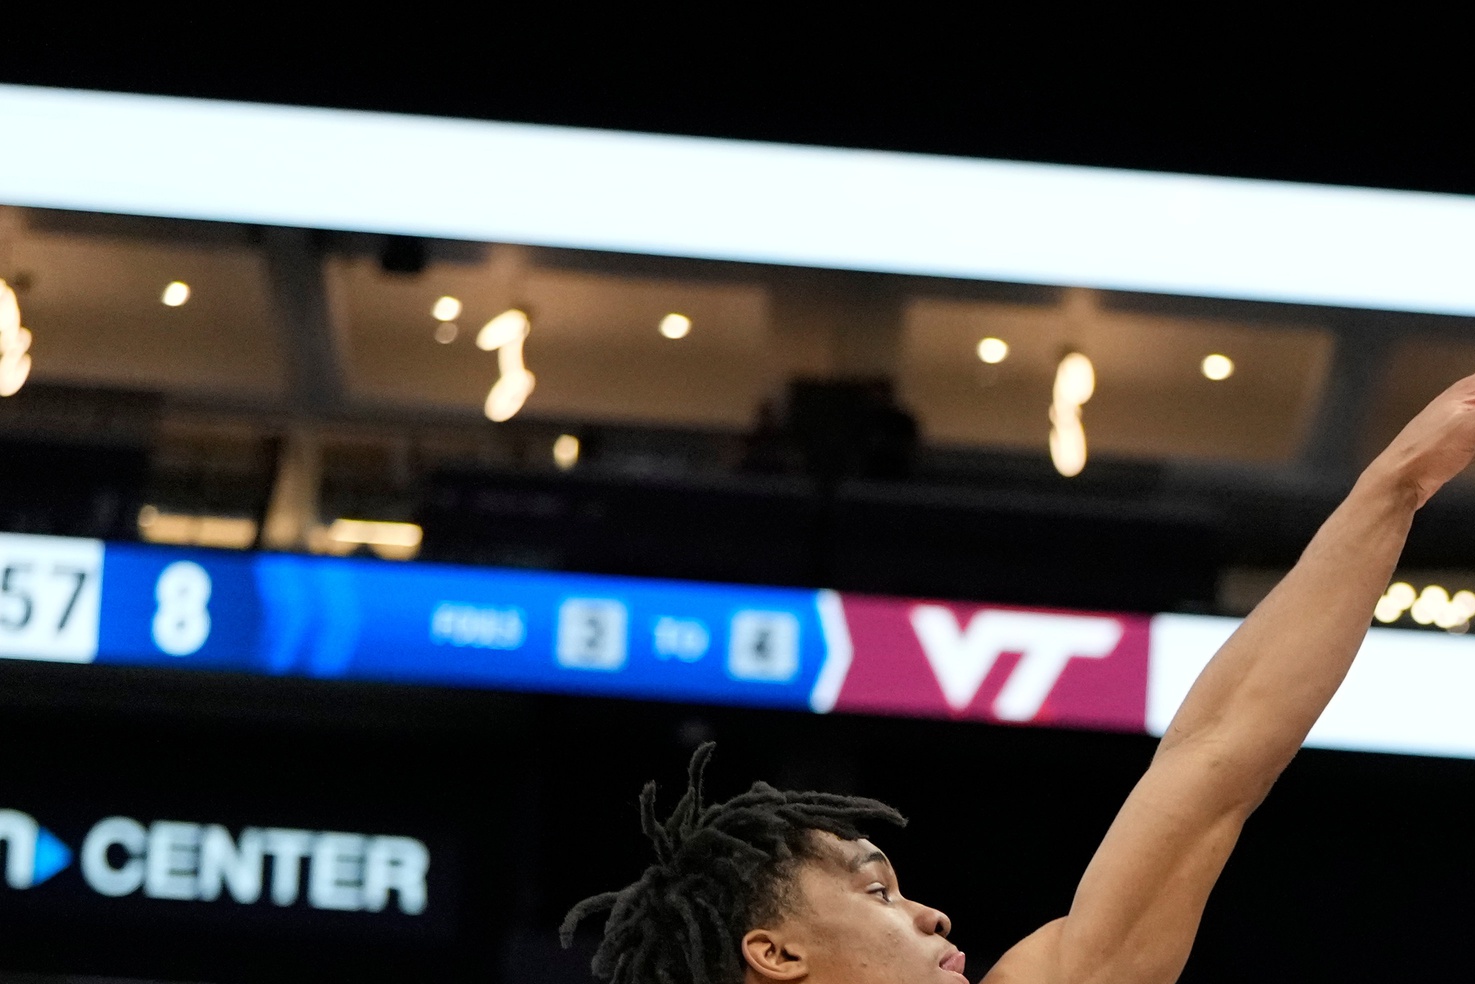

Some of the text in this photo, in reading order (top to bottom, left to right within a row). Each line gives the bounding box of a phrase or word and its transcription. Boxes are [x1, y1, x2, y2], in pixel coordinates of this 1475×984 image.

[0, 565, 88, 634] 57
[152, 560, 212, 657] 8
[910, 603, 1124, 722] VT
[81, 815, 430, 916] CENTER
